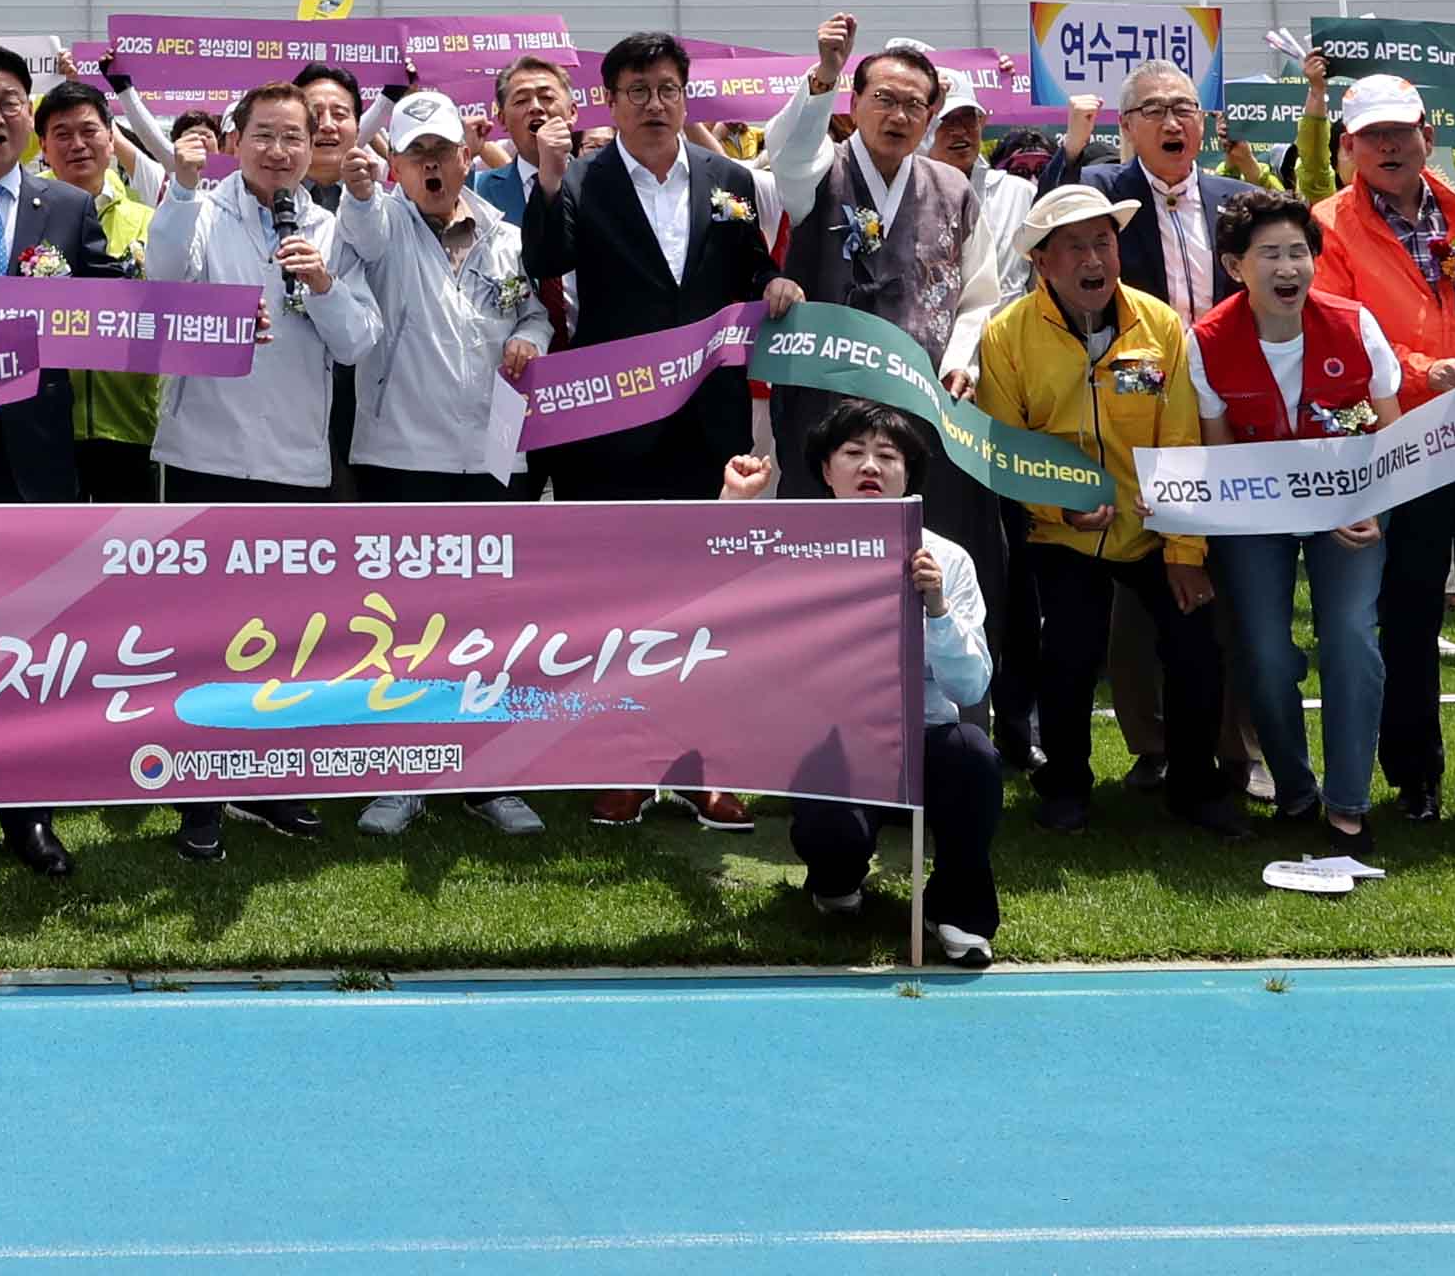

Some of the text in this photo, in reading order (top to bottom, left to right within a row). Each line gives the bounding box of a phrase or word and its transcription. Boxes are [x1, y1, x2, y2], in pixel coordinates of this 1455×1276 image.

[117, 37, 402, 64] 2025 APEC 정상회의 인천 유치를 기원합니다.
[443, 33, 511, 52] 인천 유치를
[1060, 20, 1192, 83] 연수구지회
[1323, 40, 1369, 59] 2025
[1374, 42, 1422, 62] APEC
[722, 78, 764, 96] APEC
[1227, 105, 1455, 126] 2025 it's
[52, 308, 90, 336] 인천
[97, 311, 156, 340] 유치를
[535, 349, 704, 414] 정상회의 인천 유치를
[769, 333, 816, 356] 2025
[820, 339, 882, 369] APEC
[982, 440, 1007, 469] it's
[1014, 454, 1101, 486] Incheon
[1154, 481, 1212, 504] 2025
[1220, 478, 1281, 501] APEC
[1287, 464, 1373, 498] 정상회의
[1377, 438, 1421, 482] 이제는
[103, 534, 513, 578] 2025 APEC 정상회의
[706, 530, 885, 559] 인천의 꿈 대한민국의 미래
[224, 591, 728, 714] 인천입니다
[175, 744, 462, 781] (사)대한노인회 인천광역시연합회
